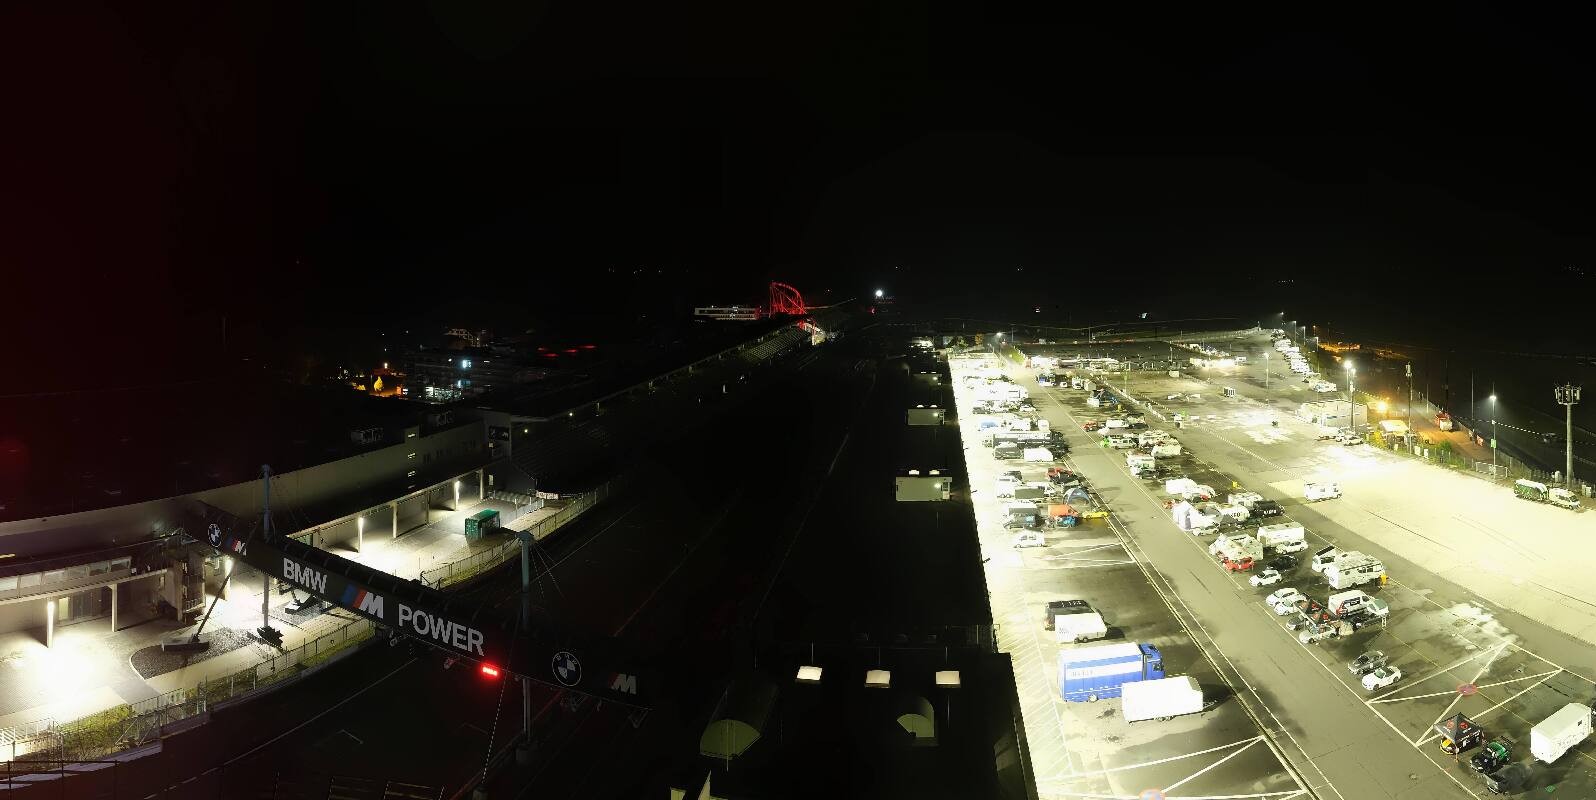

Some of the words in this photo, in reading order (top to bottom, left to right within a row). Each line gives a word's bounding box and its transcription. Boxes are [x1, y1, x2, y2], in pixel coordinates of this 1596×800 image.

[283, 557, 328, 594] BMW
[360, 591, 384, 619] M
[398, 603, 484, 657] POWER
[611, 673, 637, 695] M
